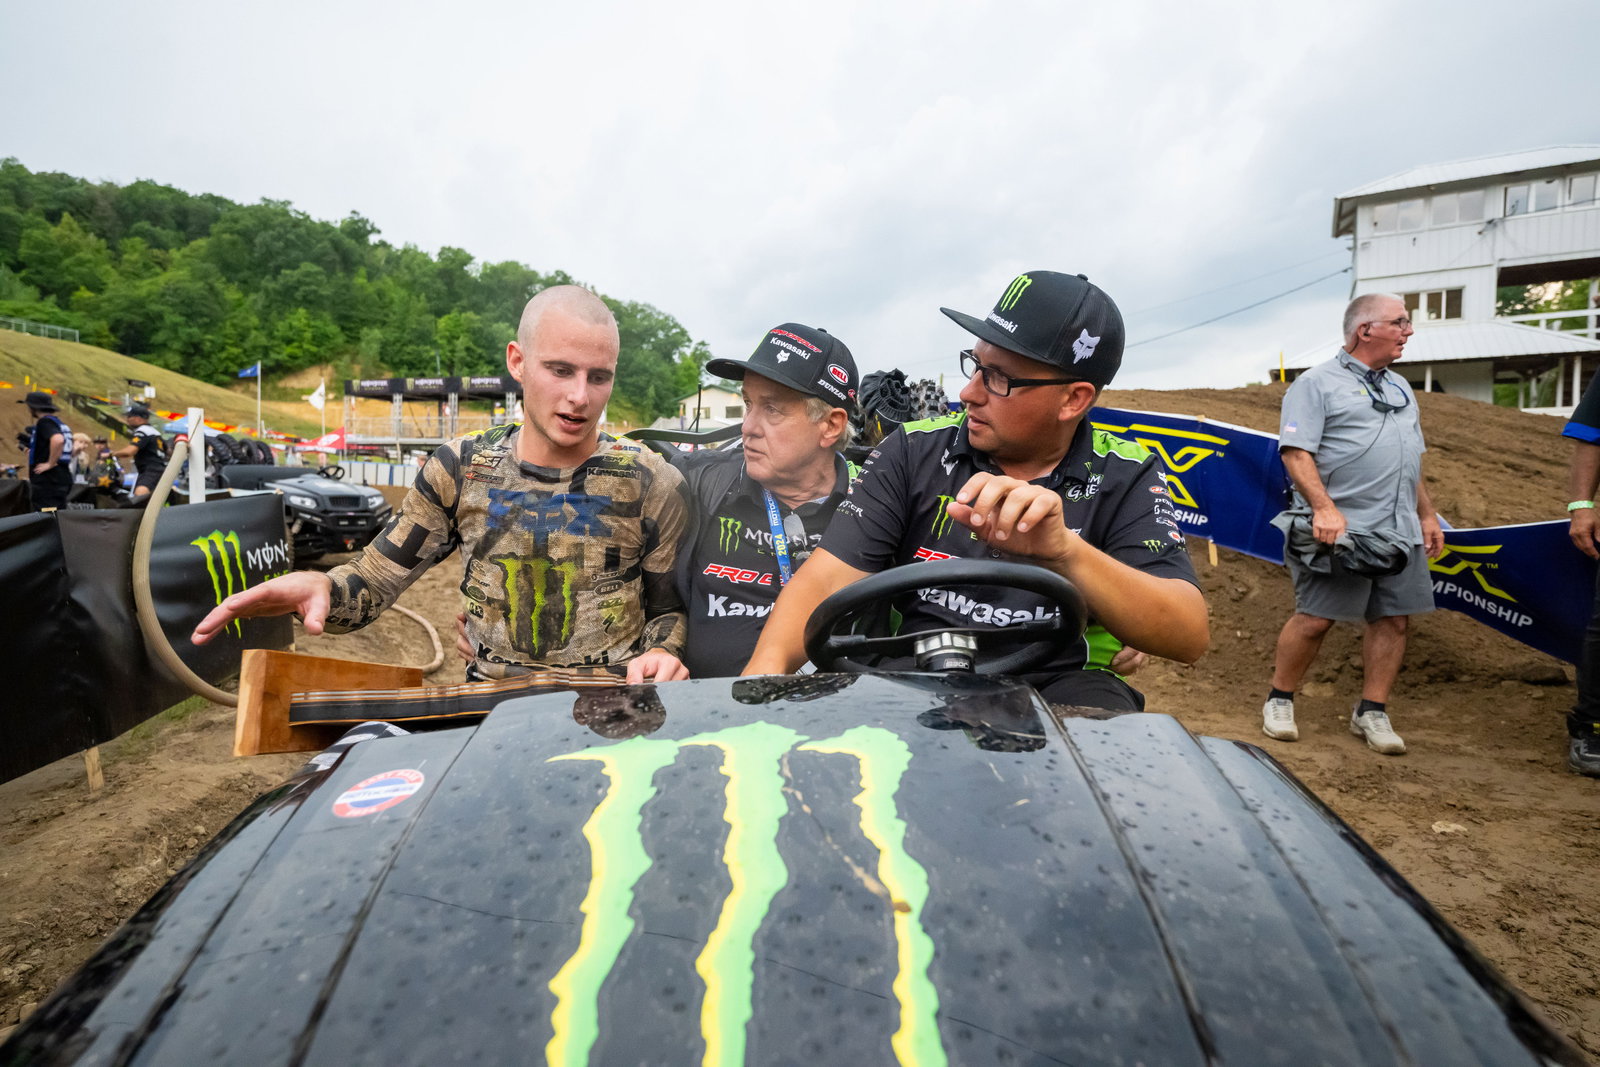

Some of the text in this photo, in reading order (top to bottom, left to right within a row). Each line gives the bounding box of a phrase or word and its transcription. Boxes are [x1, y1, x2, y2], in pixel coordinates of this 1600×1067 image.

[770, 337, 811, 360] Kawasaki
[831, 367, 847, 383] BELL
[817, 379, 847, 401] DUNLOP
[774, 533, 788, 556] 2024
[703, 563, 760, 584] PRO
[707, 593, 775, 618] Kaw
